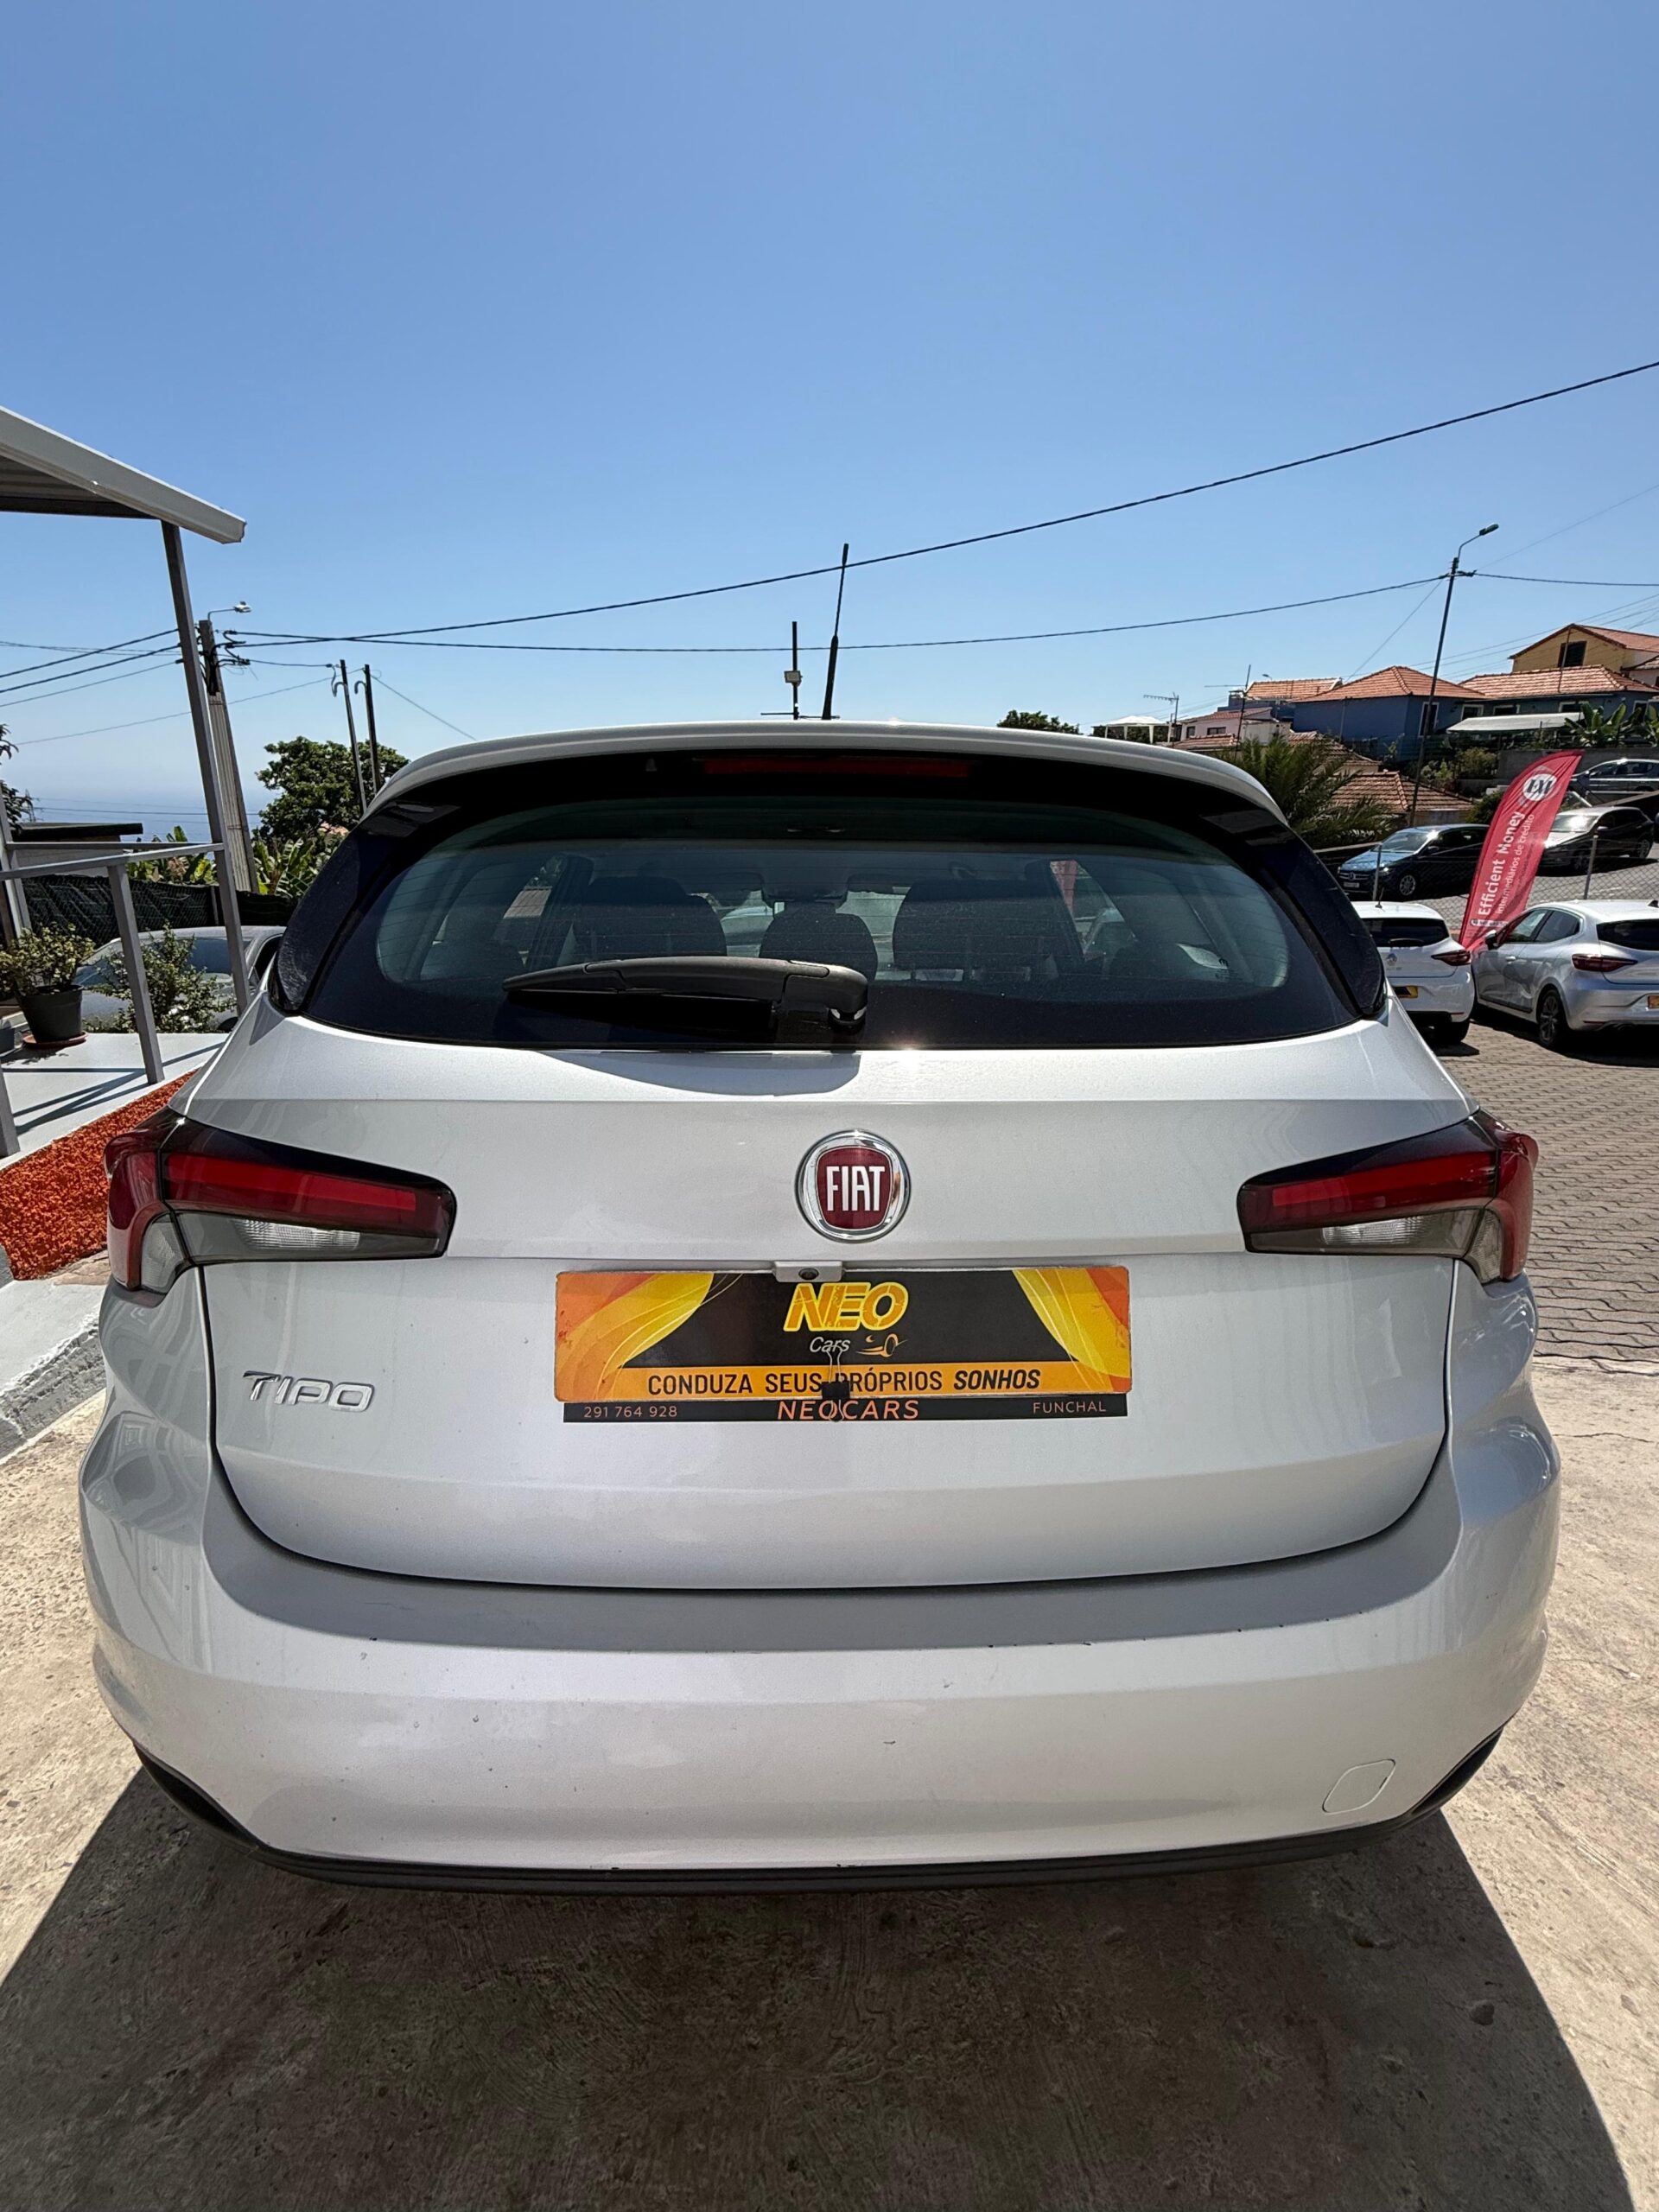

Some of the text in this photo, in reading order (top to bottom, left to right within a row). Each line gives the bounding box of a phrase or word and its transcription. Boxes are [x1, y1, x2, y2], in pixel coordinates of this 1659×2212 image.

[1515, 843, 1524, 855] de
[1478, 859, 1506, 916] Efficient
[1497, 810, 1525, 855] Money
[826, 1166, 886, 1211] FIAT
[783, 1281, 909, 1332] NEO
[810, 1337, 850, 1352] Cars
[243, 1370, 375, 1412] TIPO
[648, 1374, 753, 1395] CONDUZA
[765, 1373, 822, 1394] SEUS
[953, 1369, 1041, 1390] SONHOS
[583, 1405, 677, 1418] 291 764 928
[778, 1399, 919, 1420] NEOCARS
[1033, 1401, 1107, 1414] FUNCHAL
